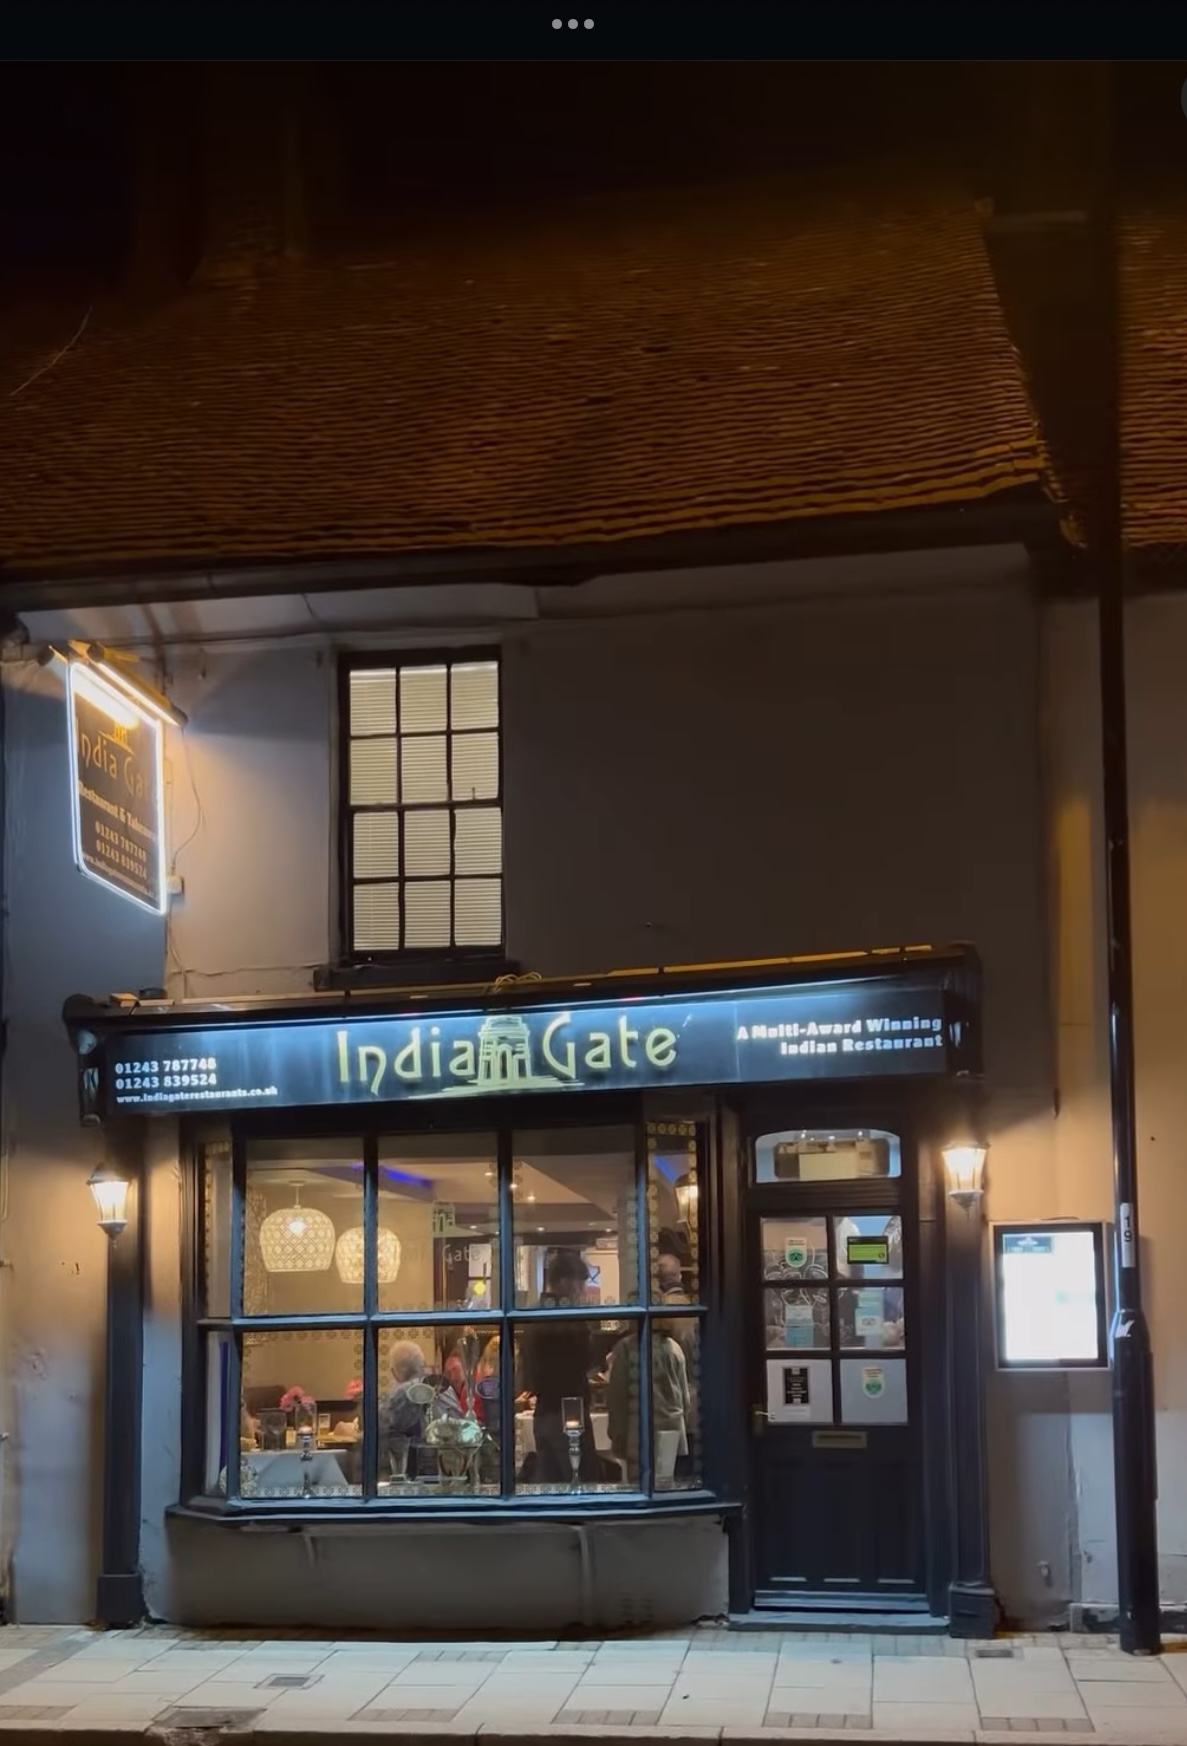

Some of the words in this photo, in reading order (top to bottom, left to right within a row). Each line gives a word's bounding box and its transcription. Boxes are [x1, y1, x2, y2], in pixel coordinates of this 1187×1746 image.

[95, 820, 119, 846] 01243
[95, 839, 120, 864] 01243
[737, 1025, 749, 1040] A
[752, 1019, 862, 1039] Multi-Award
[866, 1016, 942, 1033] Winning
[336, 1025, 476, 1096] India
[543, 1012, 677, 1079] Gate
[780, 1039, 838, 1056] Indian
[842, 1034, 943, 1052] Restaurant
[115, 1060, 159, 1074] 01243
[163, 1057, 217, 1072] 787748
[115, 1076, 160, 1090] 01243
[163, 1073, 217, 1088] 839524
[116, 1085, 278, 1103] www.indiagaterestaurants.co.uk
